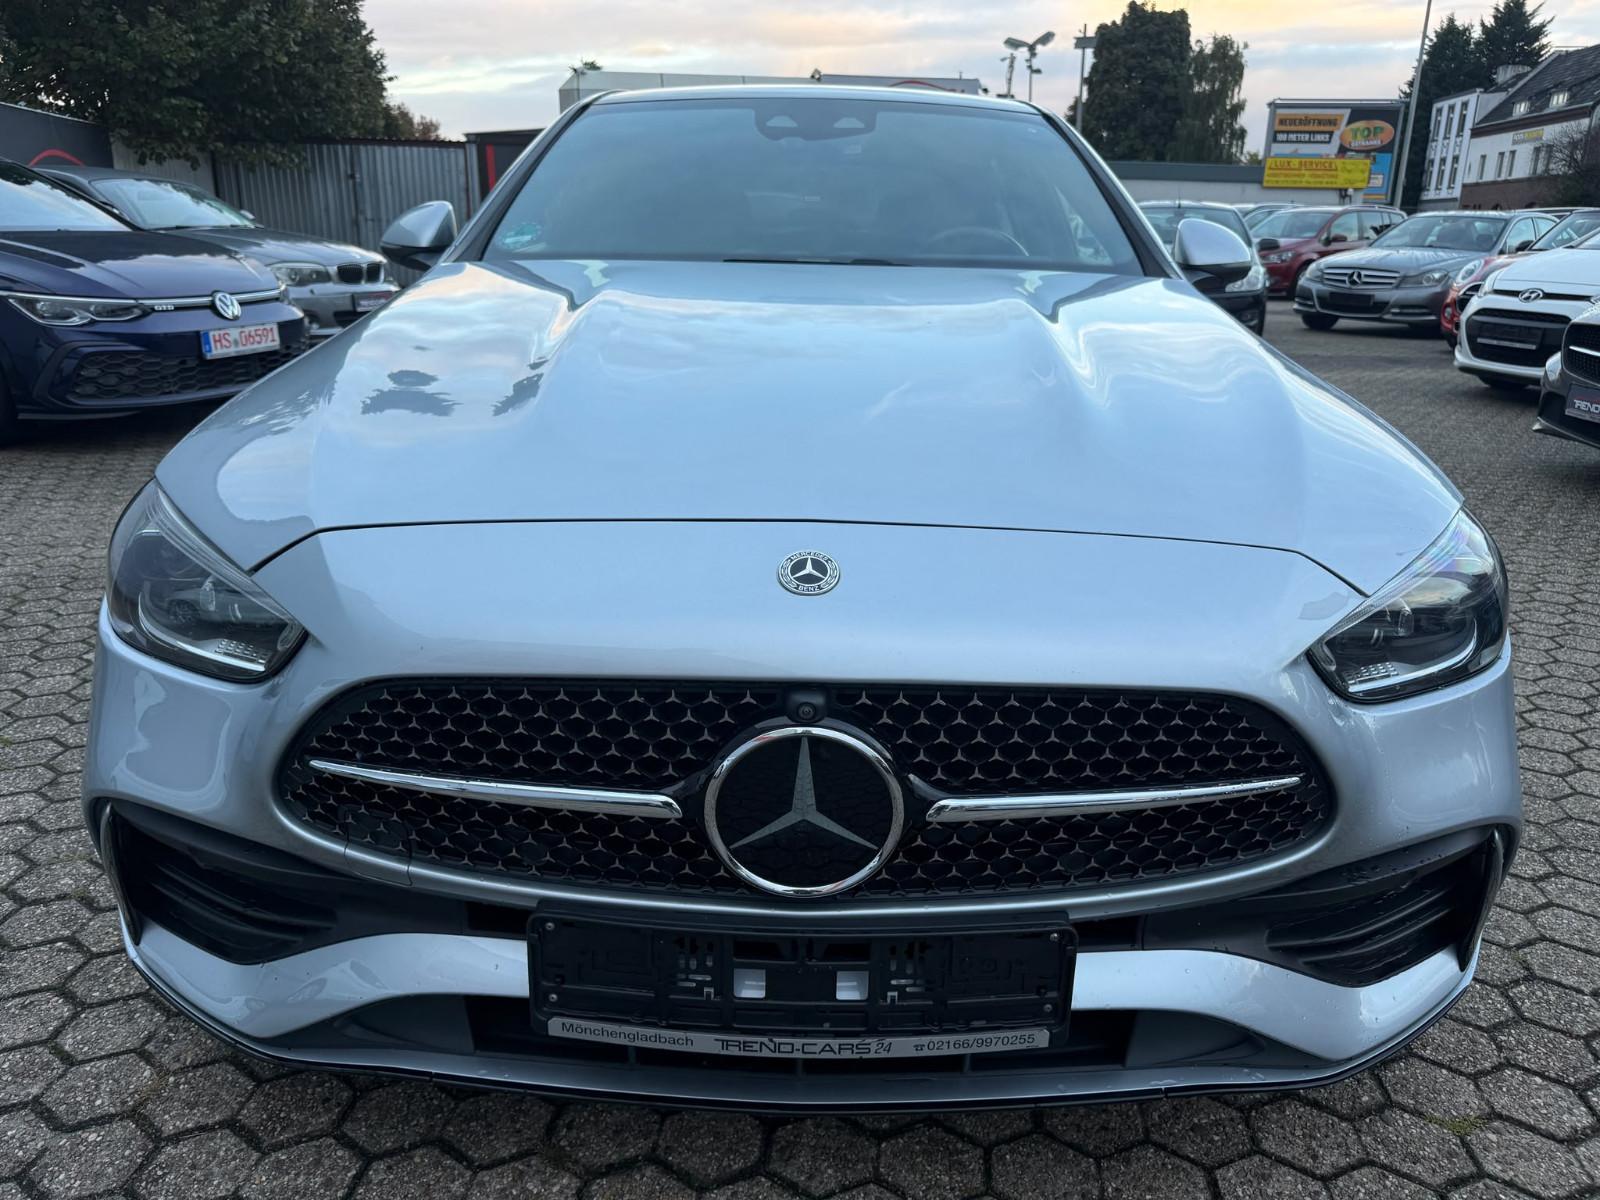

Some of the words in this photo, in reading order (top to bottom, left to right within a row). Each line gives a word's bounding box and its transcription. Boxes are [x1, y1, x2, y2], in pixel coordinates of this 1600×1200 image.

[1276, 133, 1288, 142] 100
[1288, 133, 1310, 142] METER
[1310, 133, 1331, 142] LINKS
[1350, 126, 1384, 140] TOP
[1273, 160, 1291, 168] LUX
[1299, 160, 1334, 169] SERVICE
[212, 332, 232, 351] HS
[239, 327, 276, 347] 06591
[561, 1022, 694, 1047] Mönchengladbach
[926, 1033, 1035, 1052] 02166/9970255
